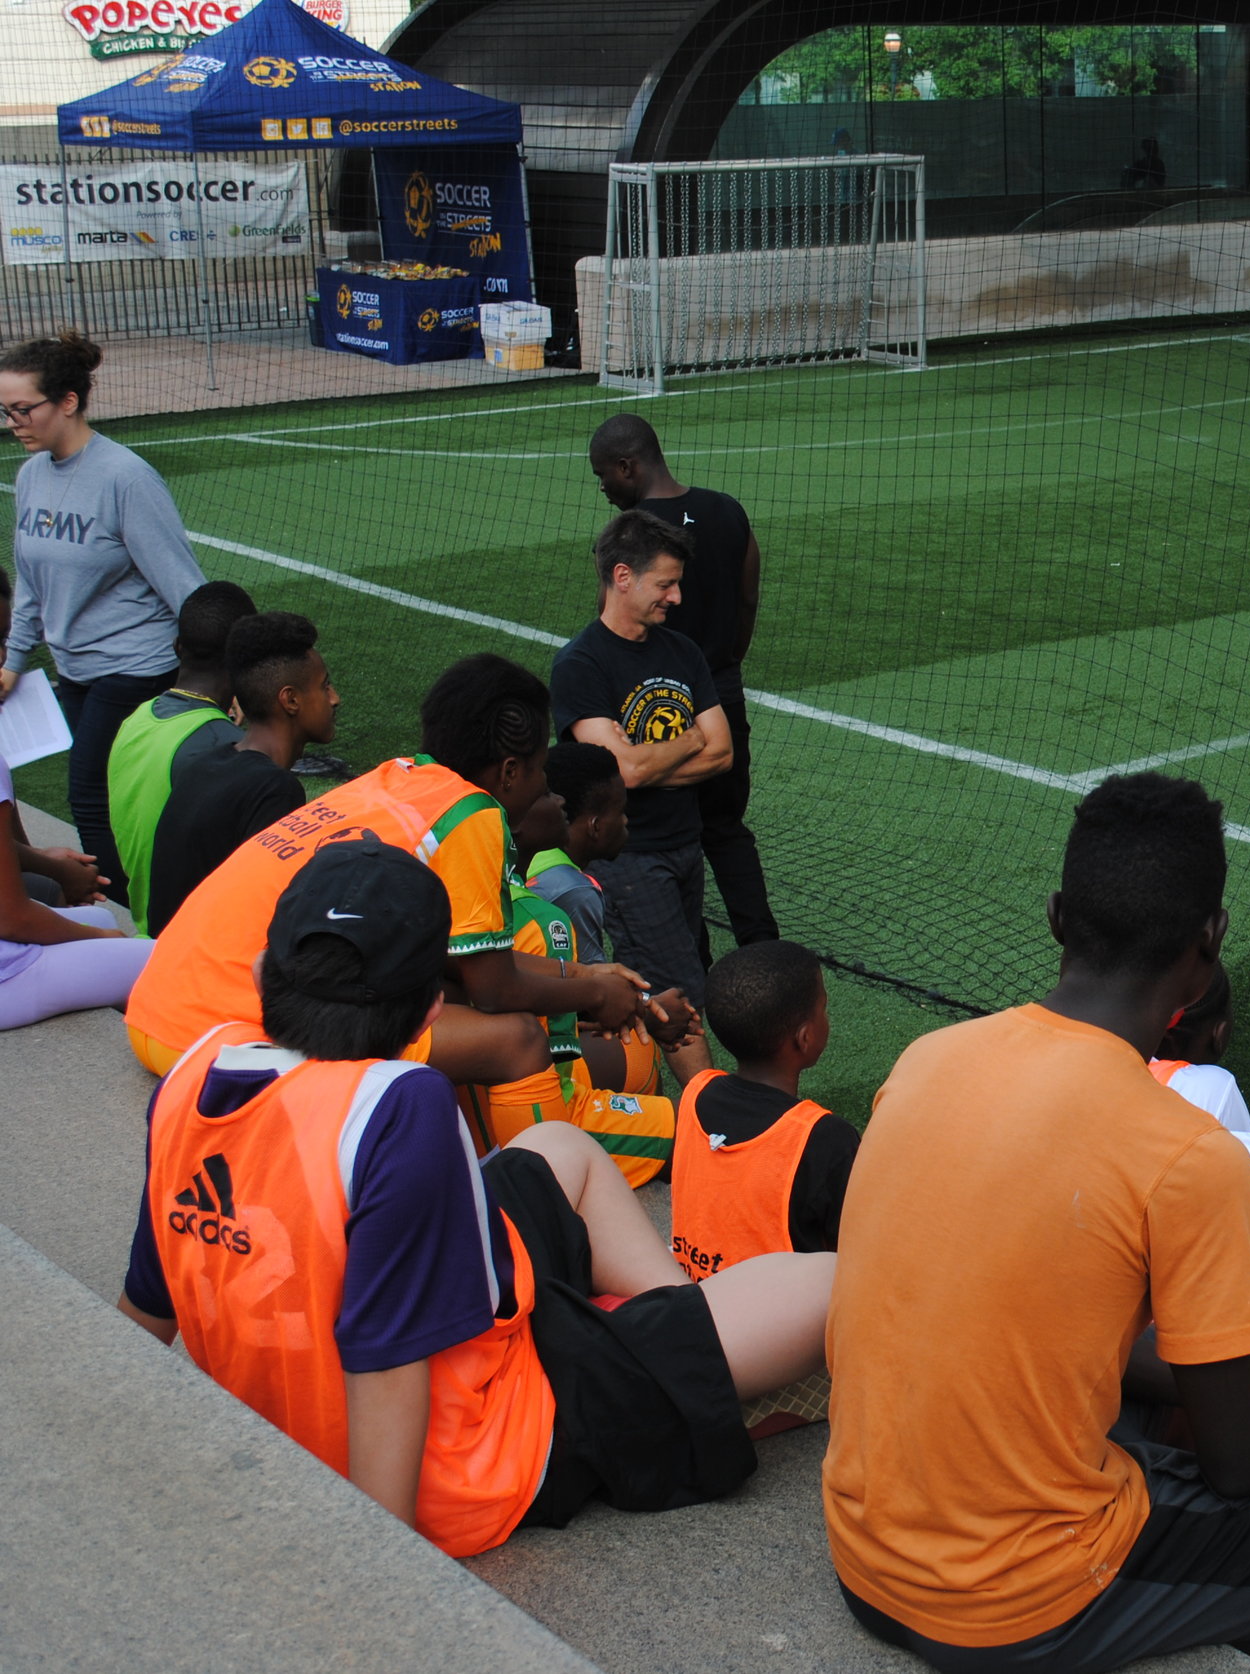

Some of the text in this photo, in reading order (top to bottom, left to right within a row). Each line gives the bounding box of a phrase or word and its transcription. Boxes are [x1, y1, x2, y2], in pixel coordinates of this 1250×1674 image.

[306, 1, 343, 9] BURGER
[103, 37, 155, 54] CHICKEN
[158, 39, 167, 48] &
[298, 56, 393, 72] SOCCER
[339, 118, 459, 136] @soccerstreets
[435, 183, 492, 208] SOCCER
[78, 231, 128, 244] marta
[352, 291, 380, 306] SOCCER
[441, 306, 475, 319] SOCCER
[18, 507, 96, 545] ARMY
[626, 699, 647, 735] SOCCER
[653, 689, 669, 698] THE
[672, 1236, 724, 1273] street
